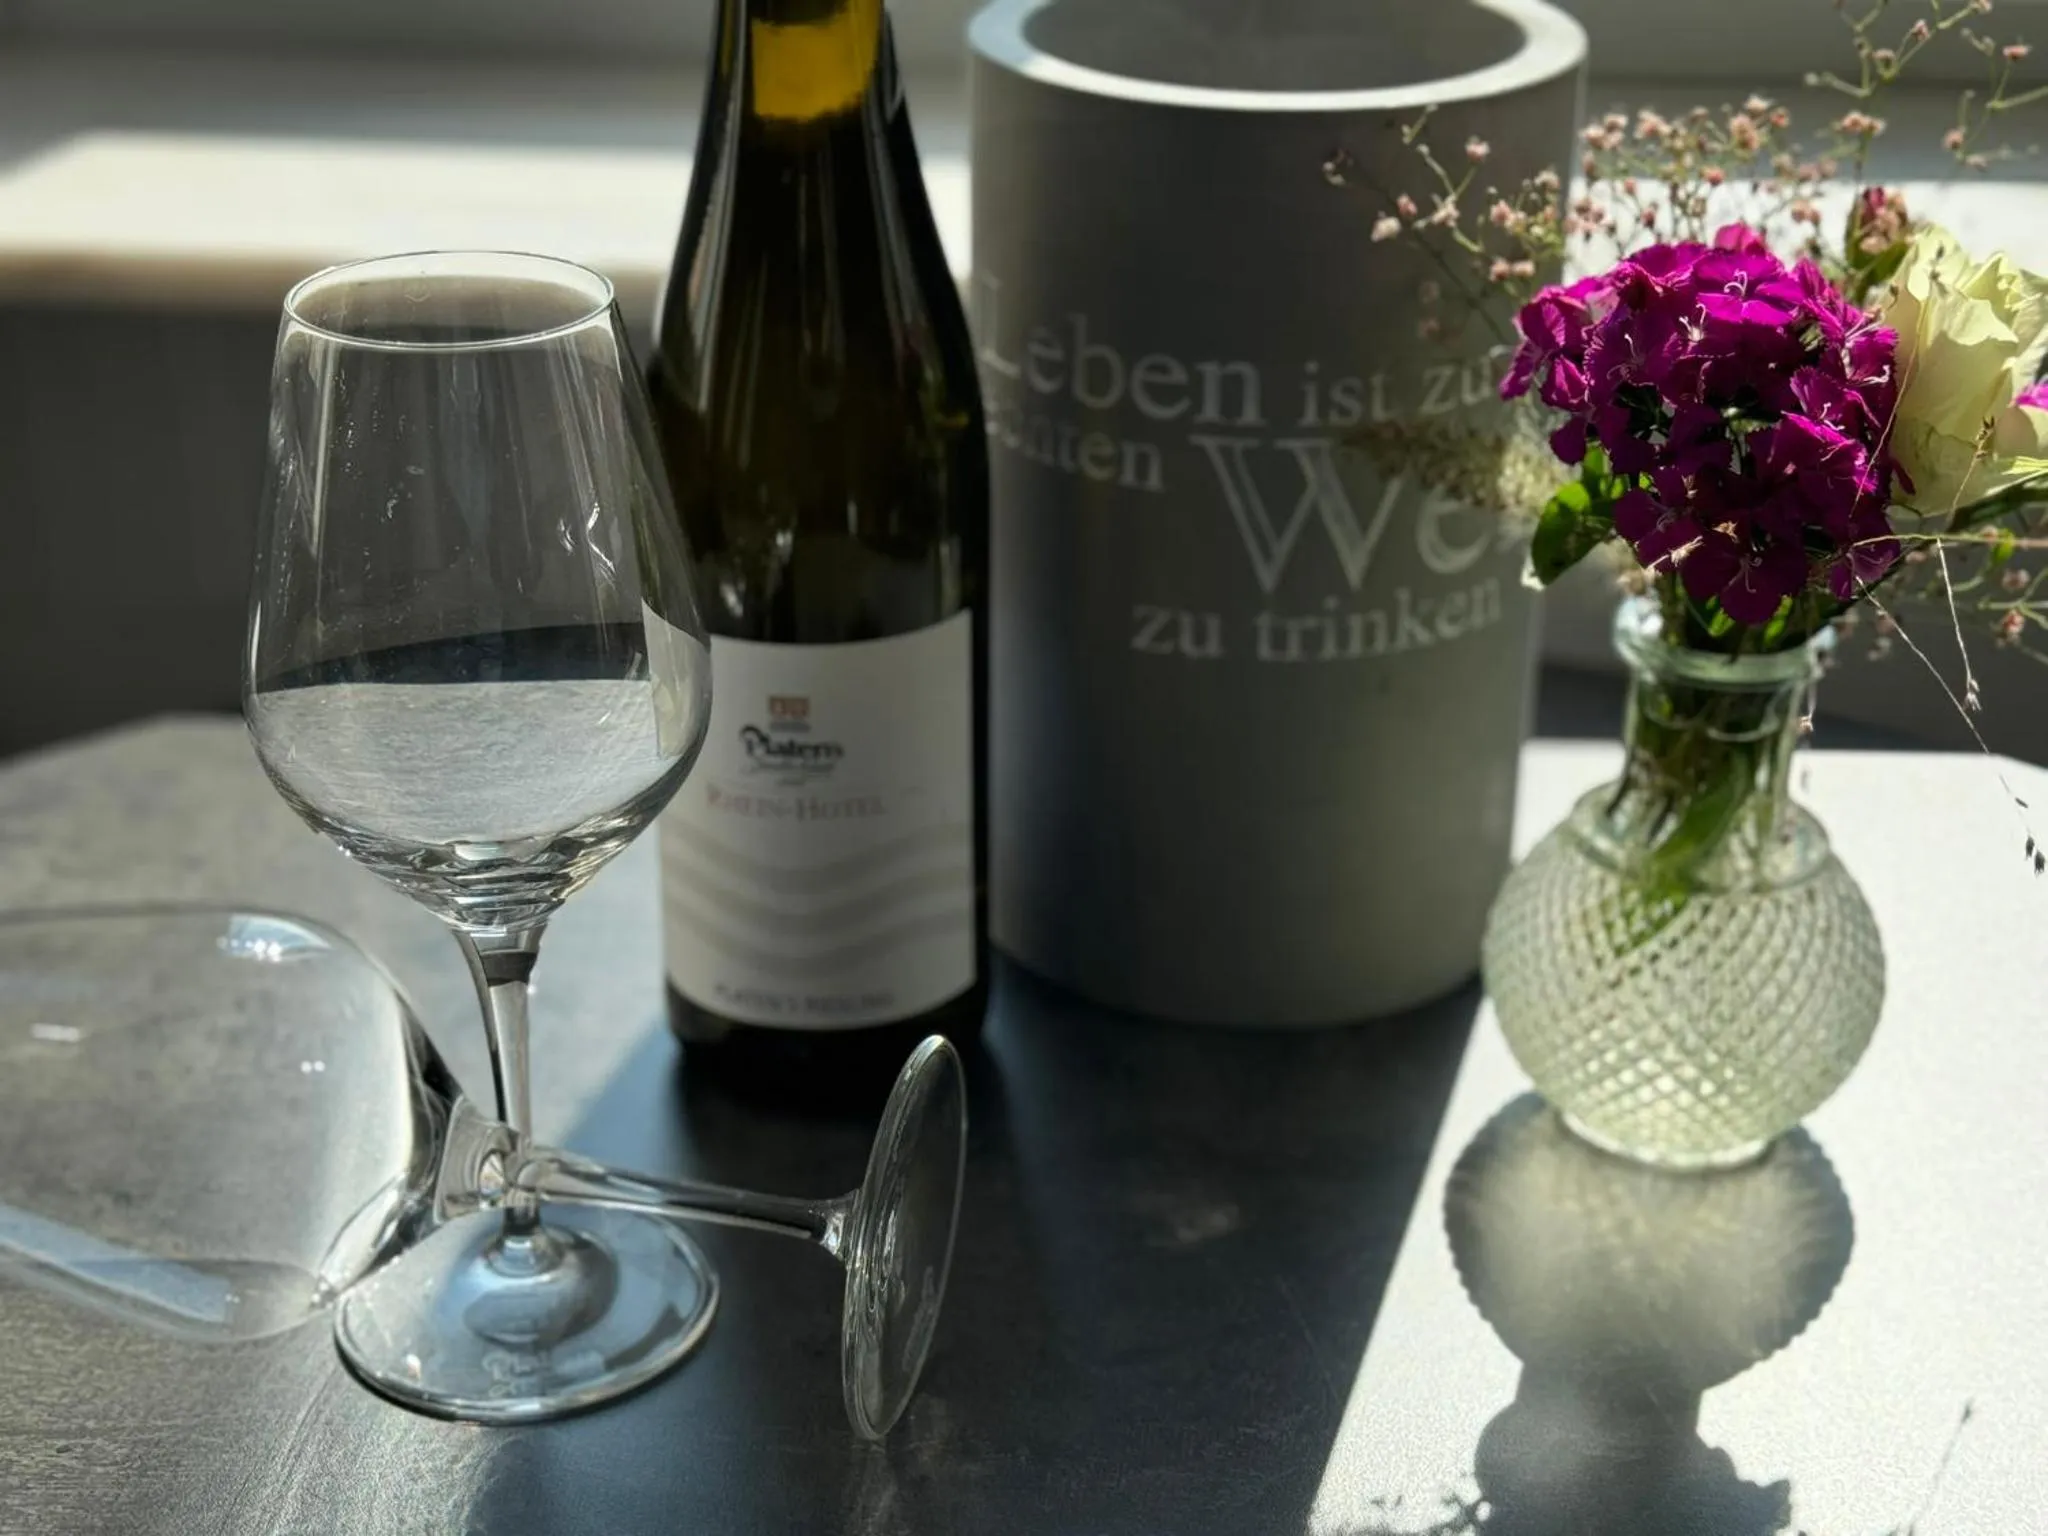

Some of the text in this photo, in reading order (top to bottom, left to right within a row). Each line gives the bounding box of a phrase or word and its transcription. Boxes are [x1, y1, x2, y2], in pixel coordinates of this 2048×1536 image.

[1299, 358, 1403, 426] ist
[1417, 355, 1497, 417] zu
[1129, 576, 1503, 662] zu trinken
